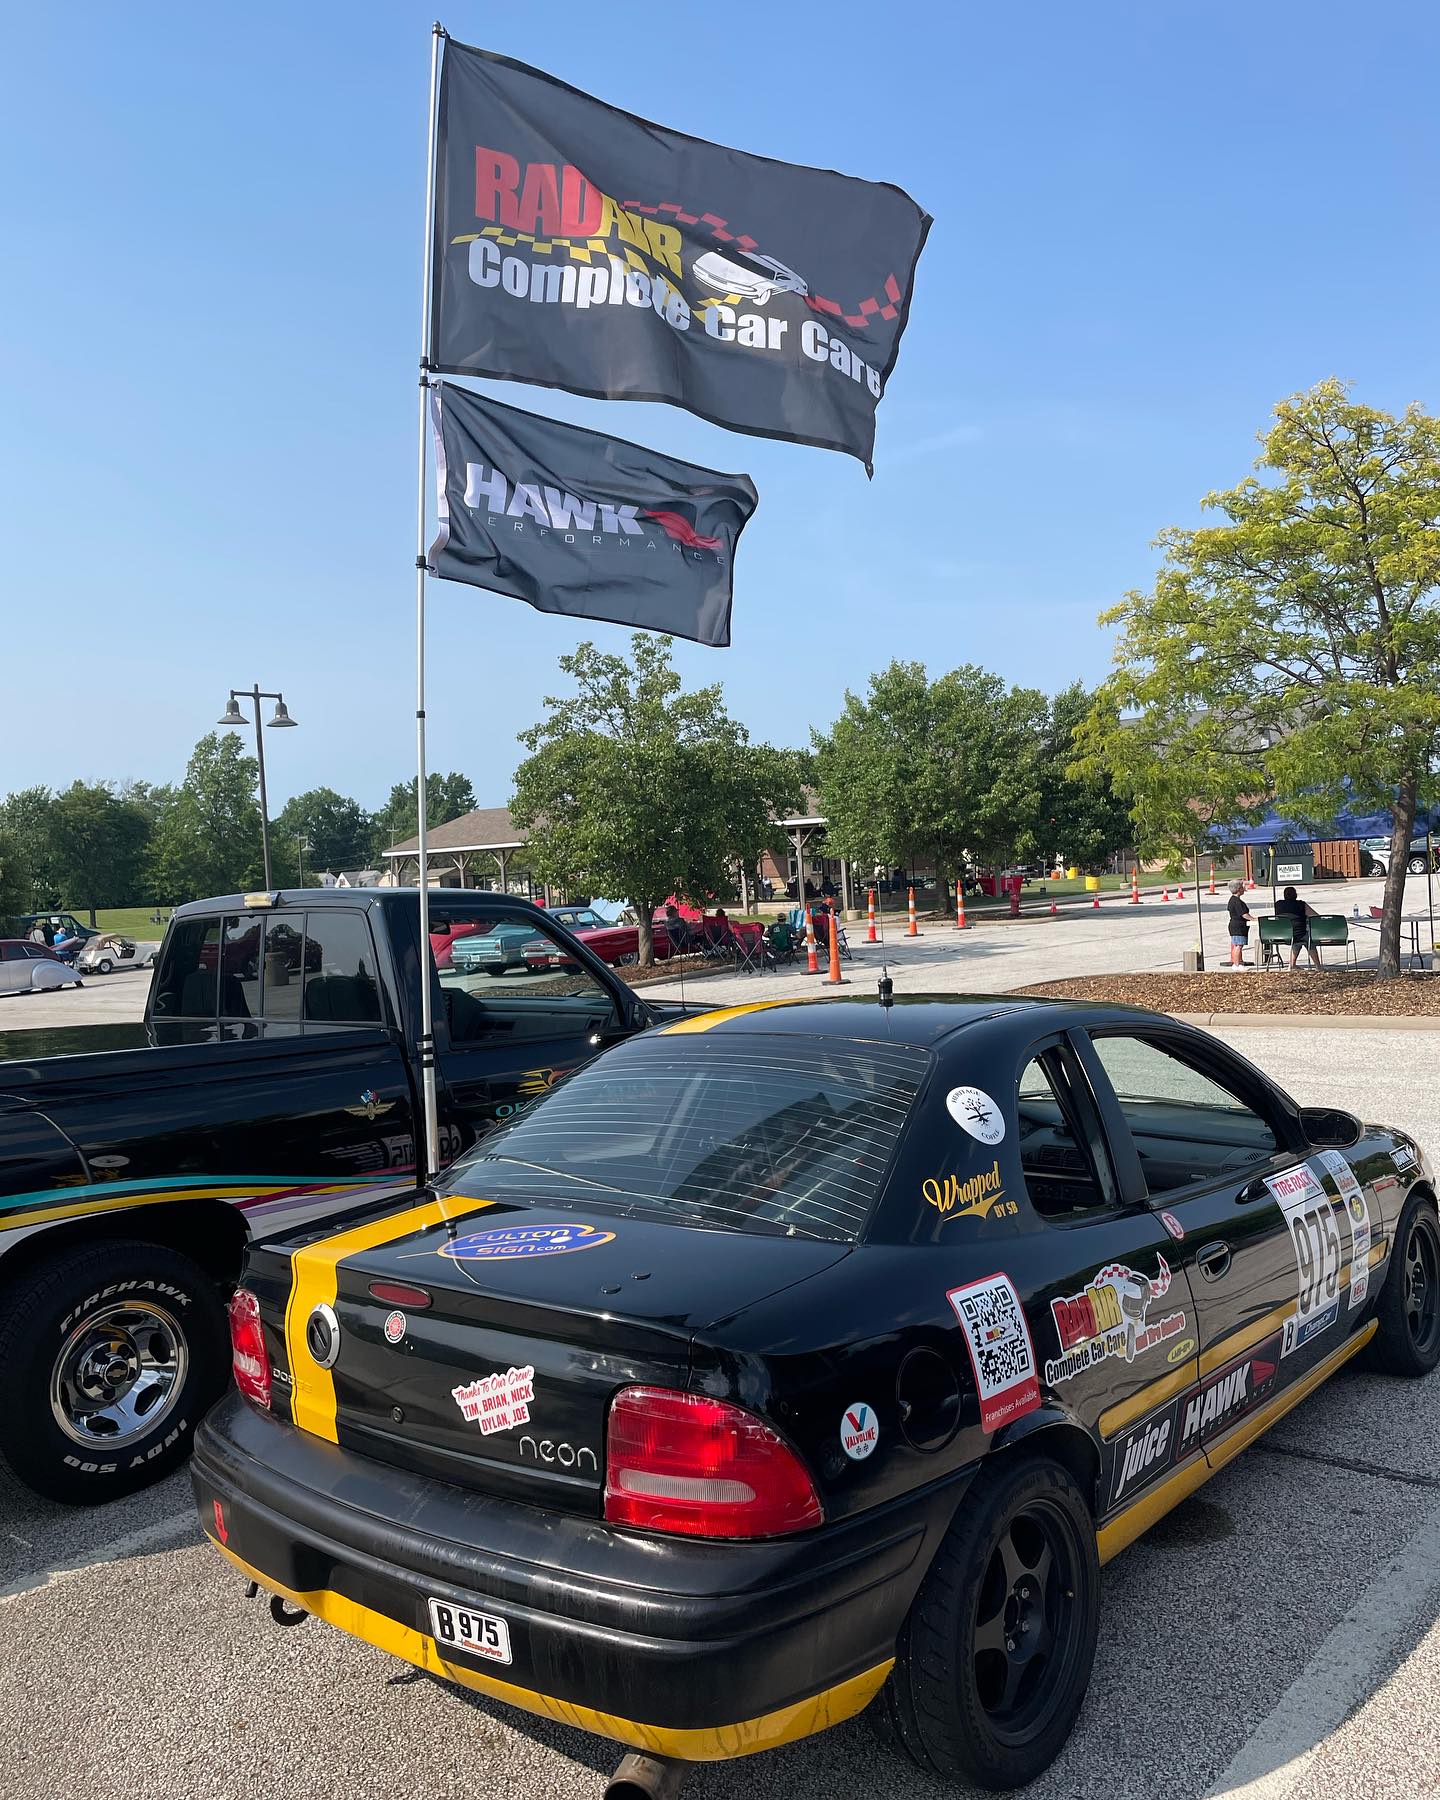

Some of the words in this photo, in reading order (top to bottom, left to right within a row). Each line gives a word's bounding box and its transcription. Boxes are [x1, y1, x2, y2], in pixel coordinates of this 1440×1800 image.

[468, 238, 691, 331] Complete
[704, 303, 788, 350] Car
[801, 320, 881, 399] Care
[463, 462, 644, 535] HAWK
[922, 1160, 1002, 1213] Wrapped
[993, 1203, 1007, 1218] BY
[1006, 1200, 1018, 1215] SB
[469, 1229, 570, 1243] FULTON
[1293, 1203, 1340, 1316] 975
[60, 1280, 192, 1335] FIREHAWK
[1285, 1321, 1294, 1353] B
[1046, 1347, 1091, 1384] Complete
[1090, 1341, 1106, 1362] Car
[1106, 1331, 1126, 1354] Care
[455, 1382, 481, 1401] Thanks
[480, 1381, 490, 1394] To
[491, 1376, 507, 1390] Our
[463, 1403, 482, 1418] TIM,
[482, 1395, 511, 1412] BRIAN,
[511, 1385, 532, 1403] NICK
[985, 1401, 1014, 1423] Franchises
[1014, 1389, 1038, 1409] Available
[1183, 1361, 1251, 1441] HAWK
[481, 1413, 511, 1432] DYLAN,
[513, 1406, 527, 1423] JOE
[844, 1426, 876, 1450] VALVOLINE
[129, 1419, 187, 1469] INDY
[519, 1435, 598, 1471] neon
[1115, 1419, 1171, 1500] juice
[63, 1455, 118, 1474] 500
[437, 1605, 455, 1642] B
[459, 1611, 499, 1647] 975
